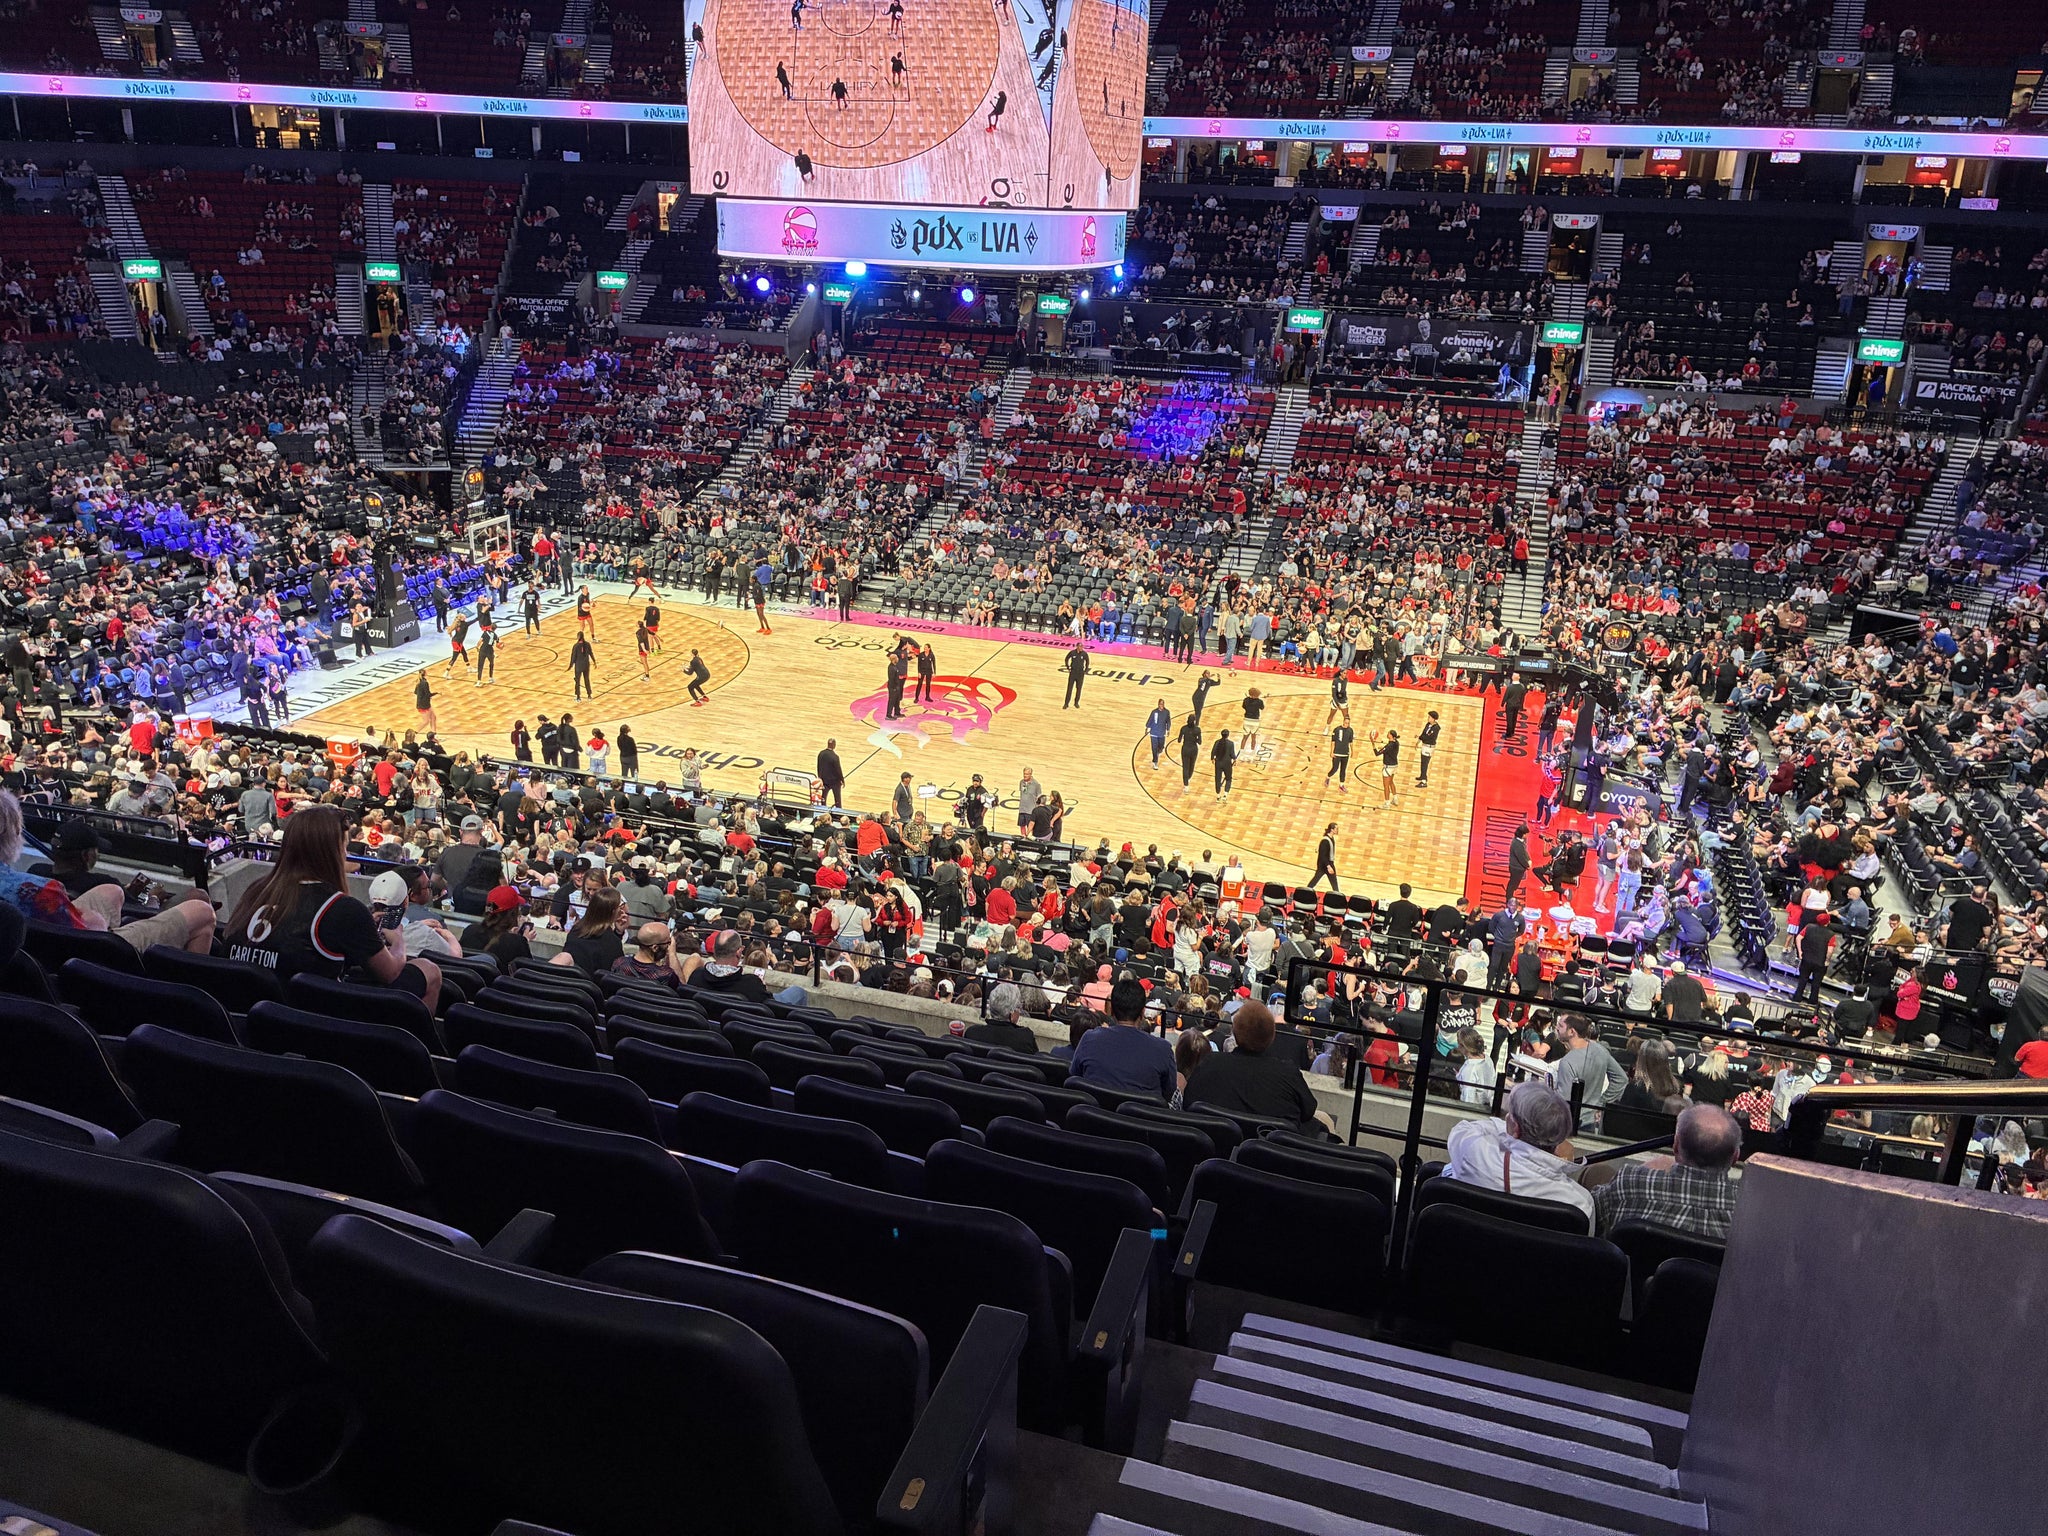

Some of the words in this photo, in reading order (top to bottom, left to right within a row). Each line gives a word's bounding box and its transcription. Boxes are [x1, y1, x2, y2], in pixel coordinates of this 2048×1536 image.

[154, 84, 170, 96] LVA
[338, 94, 353, 104] LVA
[509, 102, 524, 113] LVA
[668, 108, 682, 119] LVA
[1306, 124, 1321, 136] LVA
[1490, 128, 1505, 140] LVA
[1688, 131, 1704, 143] LVA
[1898, 136, 1914, 149] LVA
[1583, 215, 1598, 223] 218
[1870, 225, 1886, 233] 218
[1901, 226, 1918, 234] 219
[981, 221, 1020, 253] LVA
[126, 263, 158, 275] chime
[368, 266, 398, 278] chime
[600, 275, 627, 286] chime
[826, 288, 852, 299] chime
[518, 297, 543, 305] PACIFIC
[545, 298, 569, 306] OFFICE
[1040, 298, 1067, 311] chime
[519, 304, 564, 313] AUTOMATION
[1291, 313, 1322, 325] chime
[1546, 326, 1580, 340] chime
[1366, 335, 1385, 344] 620
[1862, 344, 1900, 358] chime
[1939, 382, 1976, 394] PACIFIC
[393, 619, 416, 633] LASHIFY
[361, 657, 426, 681] FIRE
[334, 744, 343, 754] G
[247, 904, 273, 943] 6
[1526, 922, 1533, 930] G
[1559, 925, 1567, 933] G
[1954, 993, 1968, 1003] ZONE
